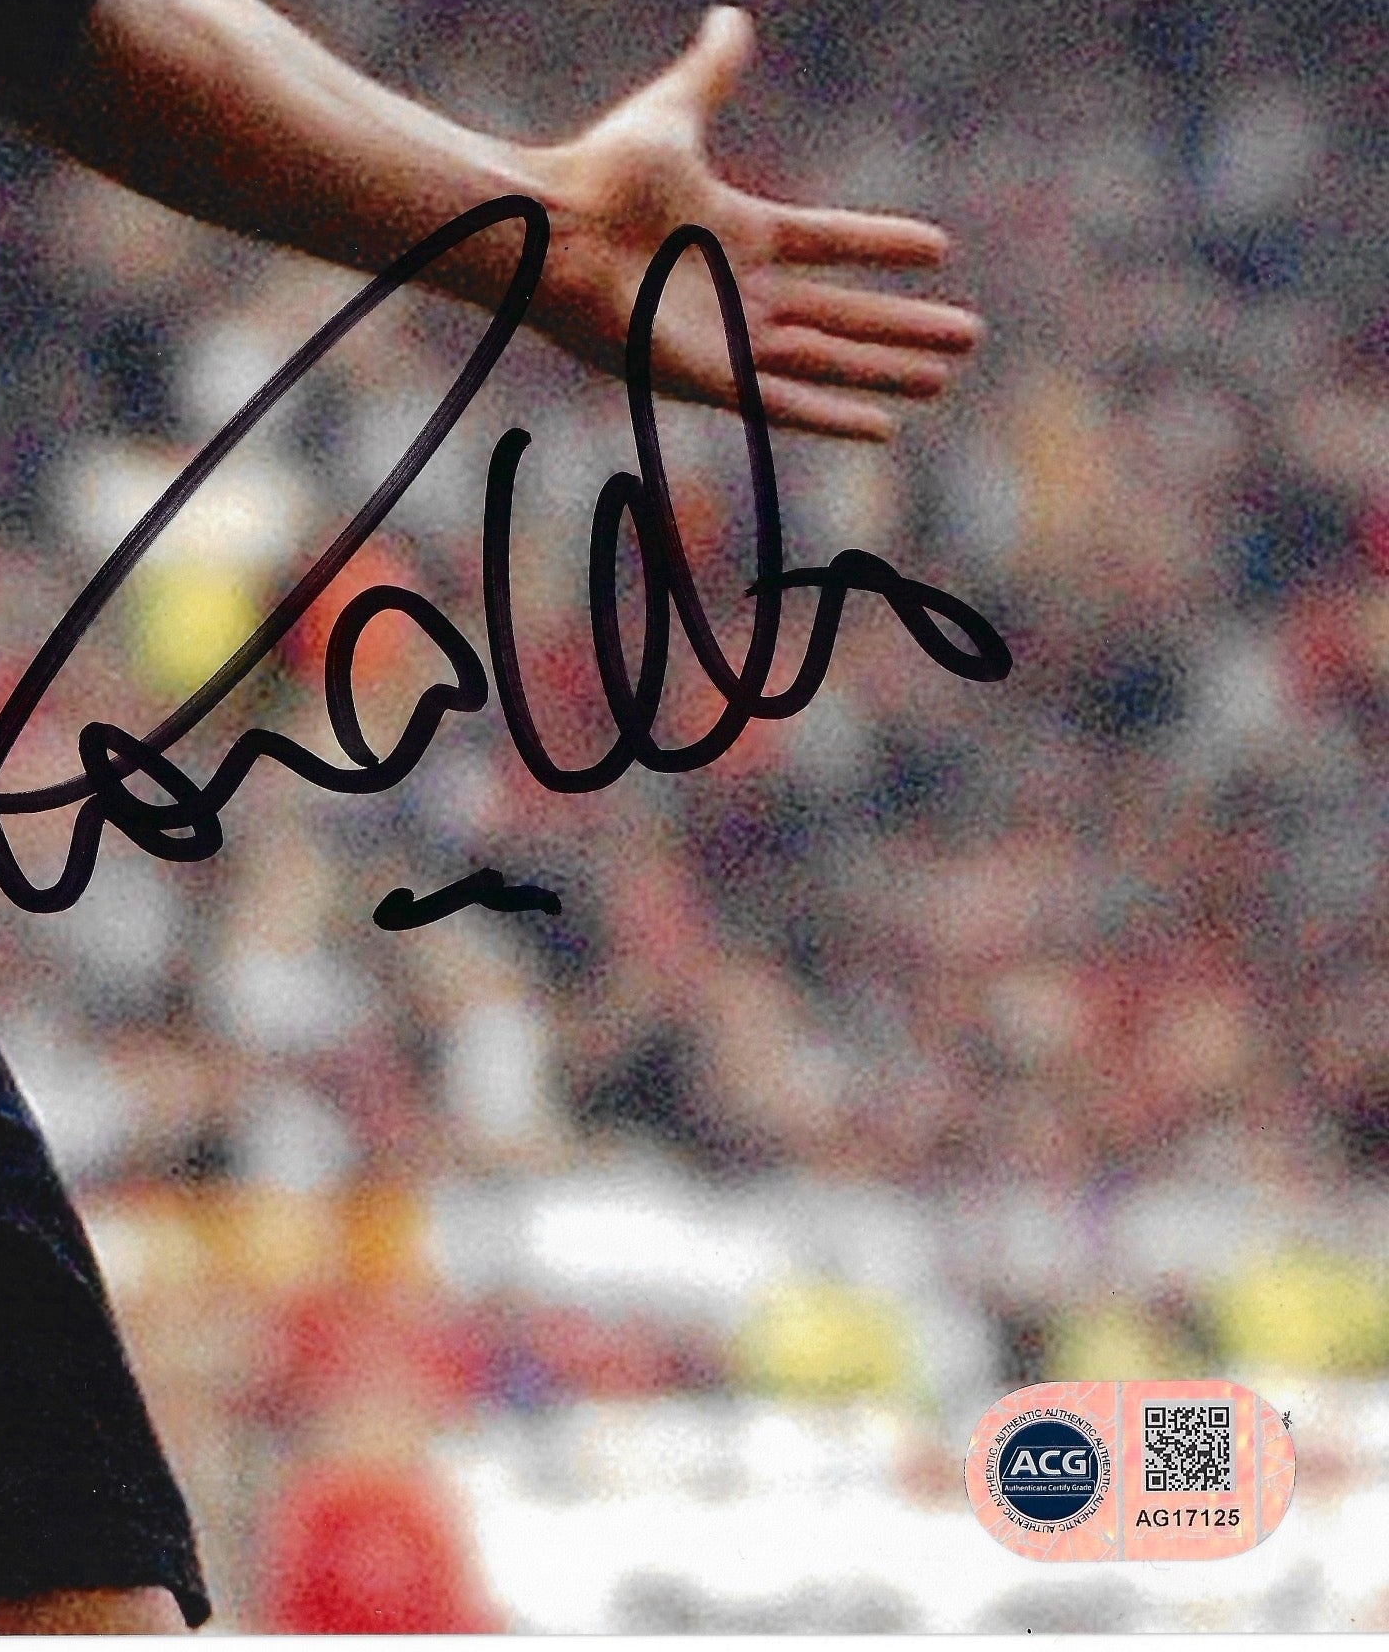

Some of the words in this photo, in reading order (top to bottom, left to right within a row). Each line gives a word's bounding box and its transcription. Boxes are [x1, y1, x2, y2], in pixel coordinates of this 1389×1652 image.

[994, 1409, 1042, 1446] AUTHENTIC
[1044, 1408, 1097, 1437] AUTHENTIC
[985, 1447, 1005, 1507] AUTHENTIC
[1010, 1450, 1087, 1476] ACG
[1094, 1437, 1111, 1493] AUTHENTIC
[1004, 1484, 1047, 1492] Authenticate
[1048, 1484, 1071, 1493] Certify
[1002, 1507, 1055, 1534] AUTHENTIC
[1059, 1494, 1104, 1532] AUTHENTIC
[1136, 1509, 1240, 1527] AG17125
